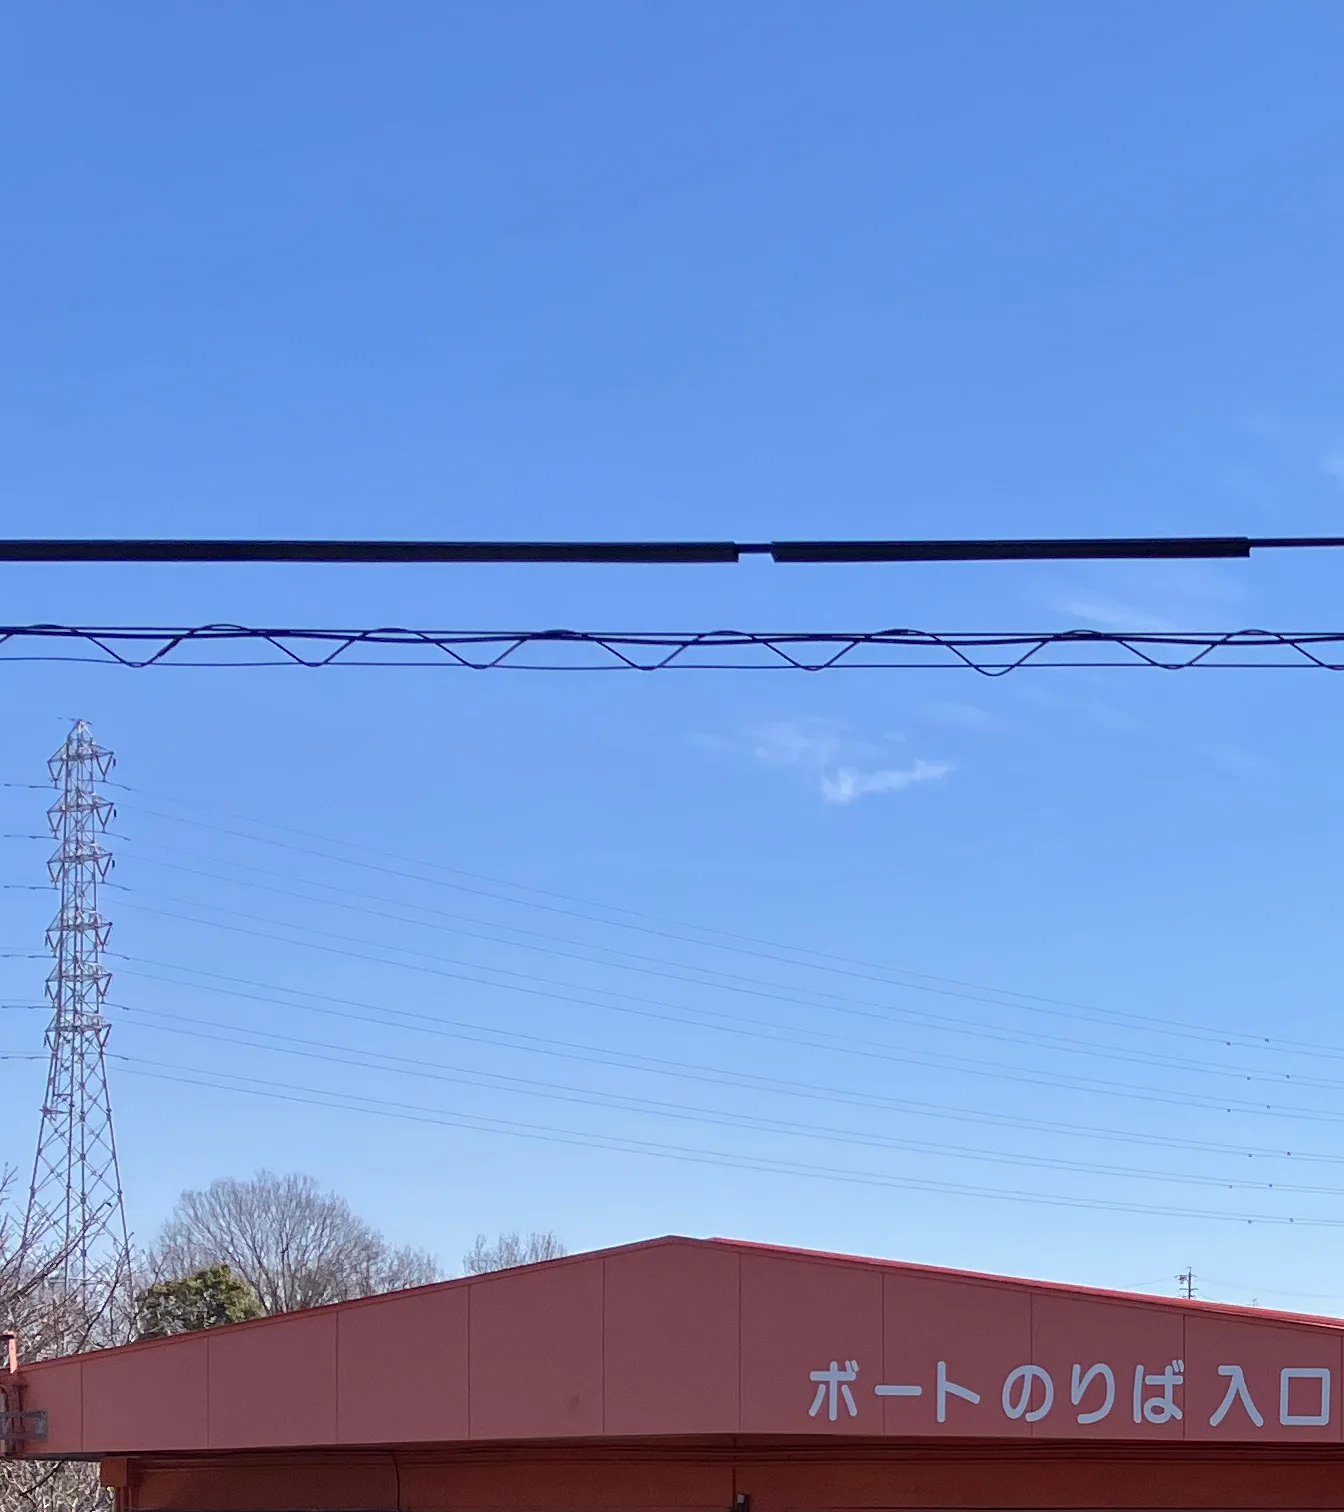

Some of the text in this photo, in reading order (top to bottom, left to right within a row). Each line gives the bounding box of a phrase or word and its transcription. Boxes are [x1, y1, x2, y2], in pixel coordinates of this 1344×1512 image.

[808, 1359, 1332, 1427] ボートのりば入口
